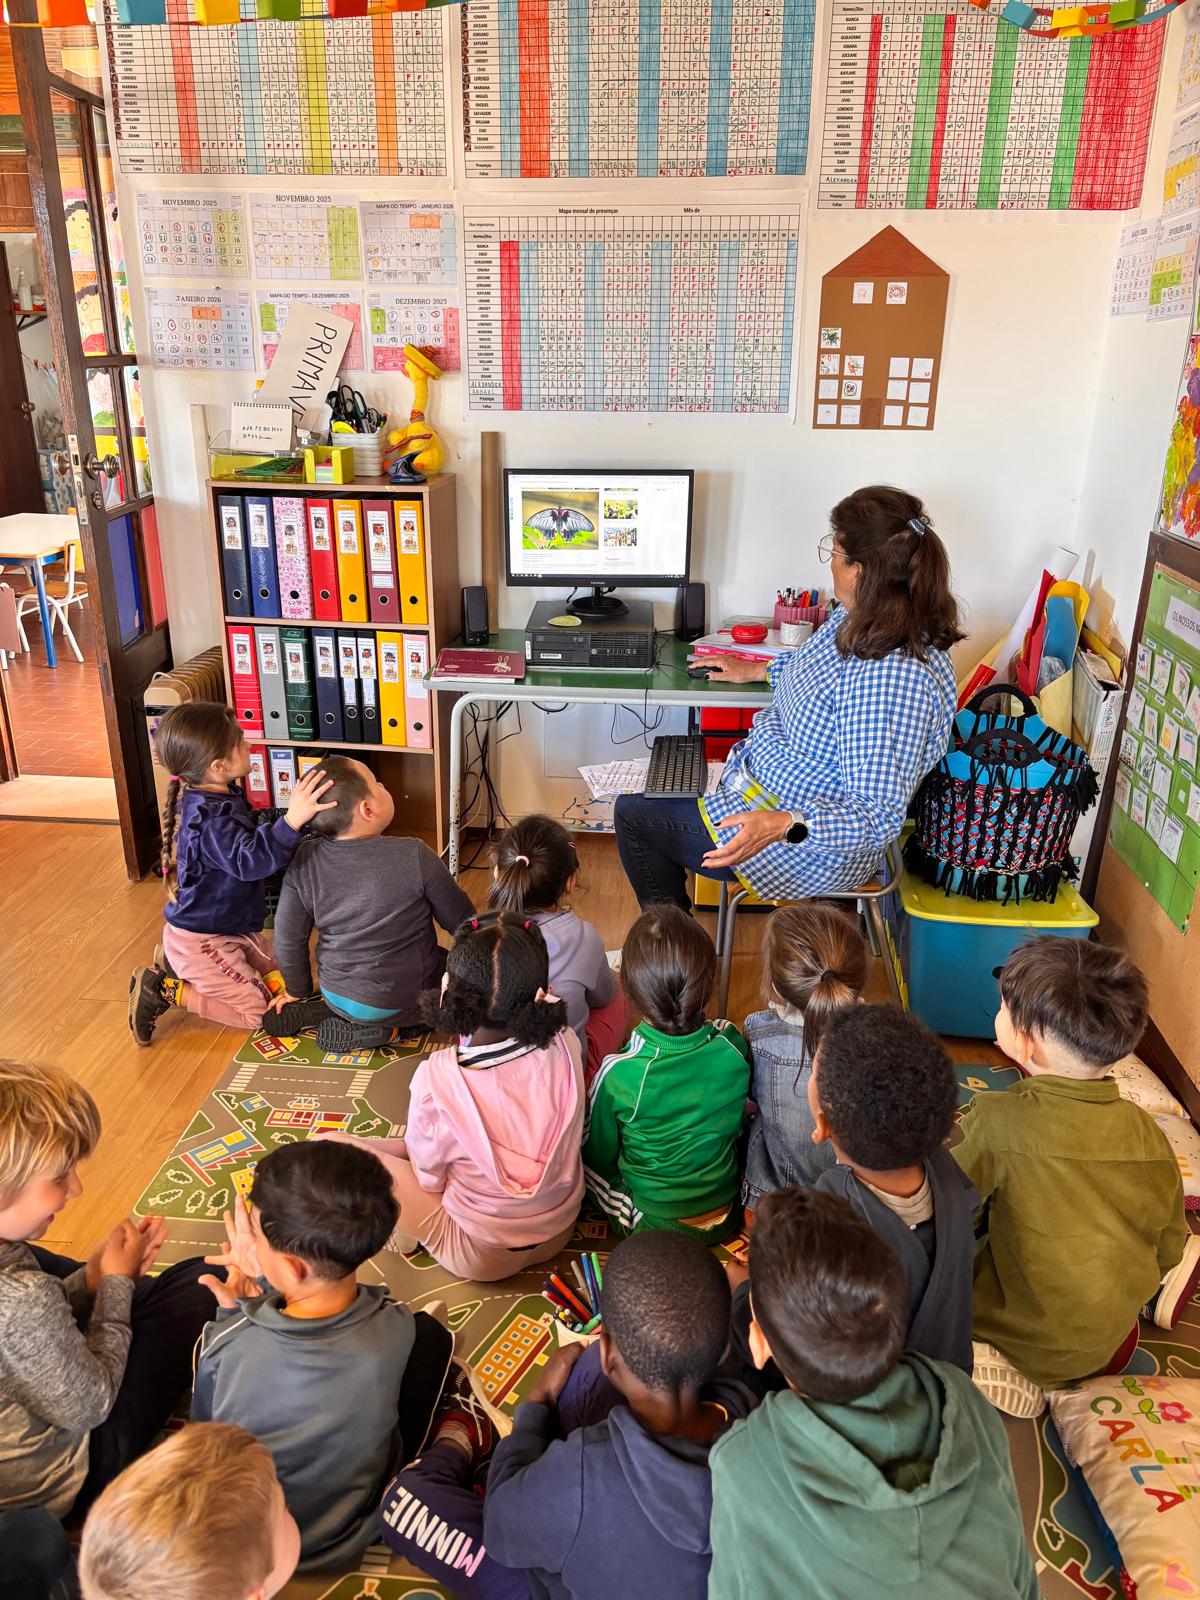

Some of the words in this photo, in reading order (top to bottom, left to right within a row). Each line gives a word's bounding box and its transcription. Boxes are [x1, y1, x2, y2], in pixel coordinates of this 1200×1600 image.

[288, 322, 337, 428] PRIMAV
[1090, 1396, 1185, 1513] CARLA
[383, 1486, 486, 1578] MINNIE
